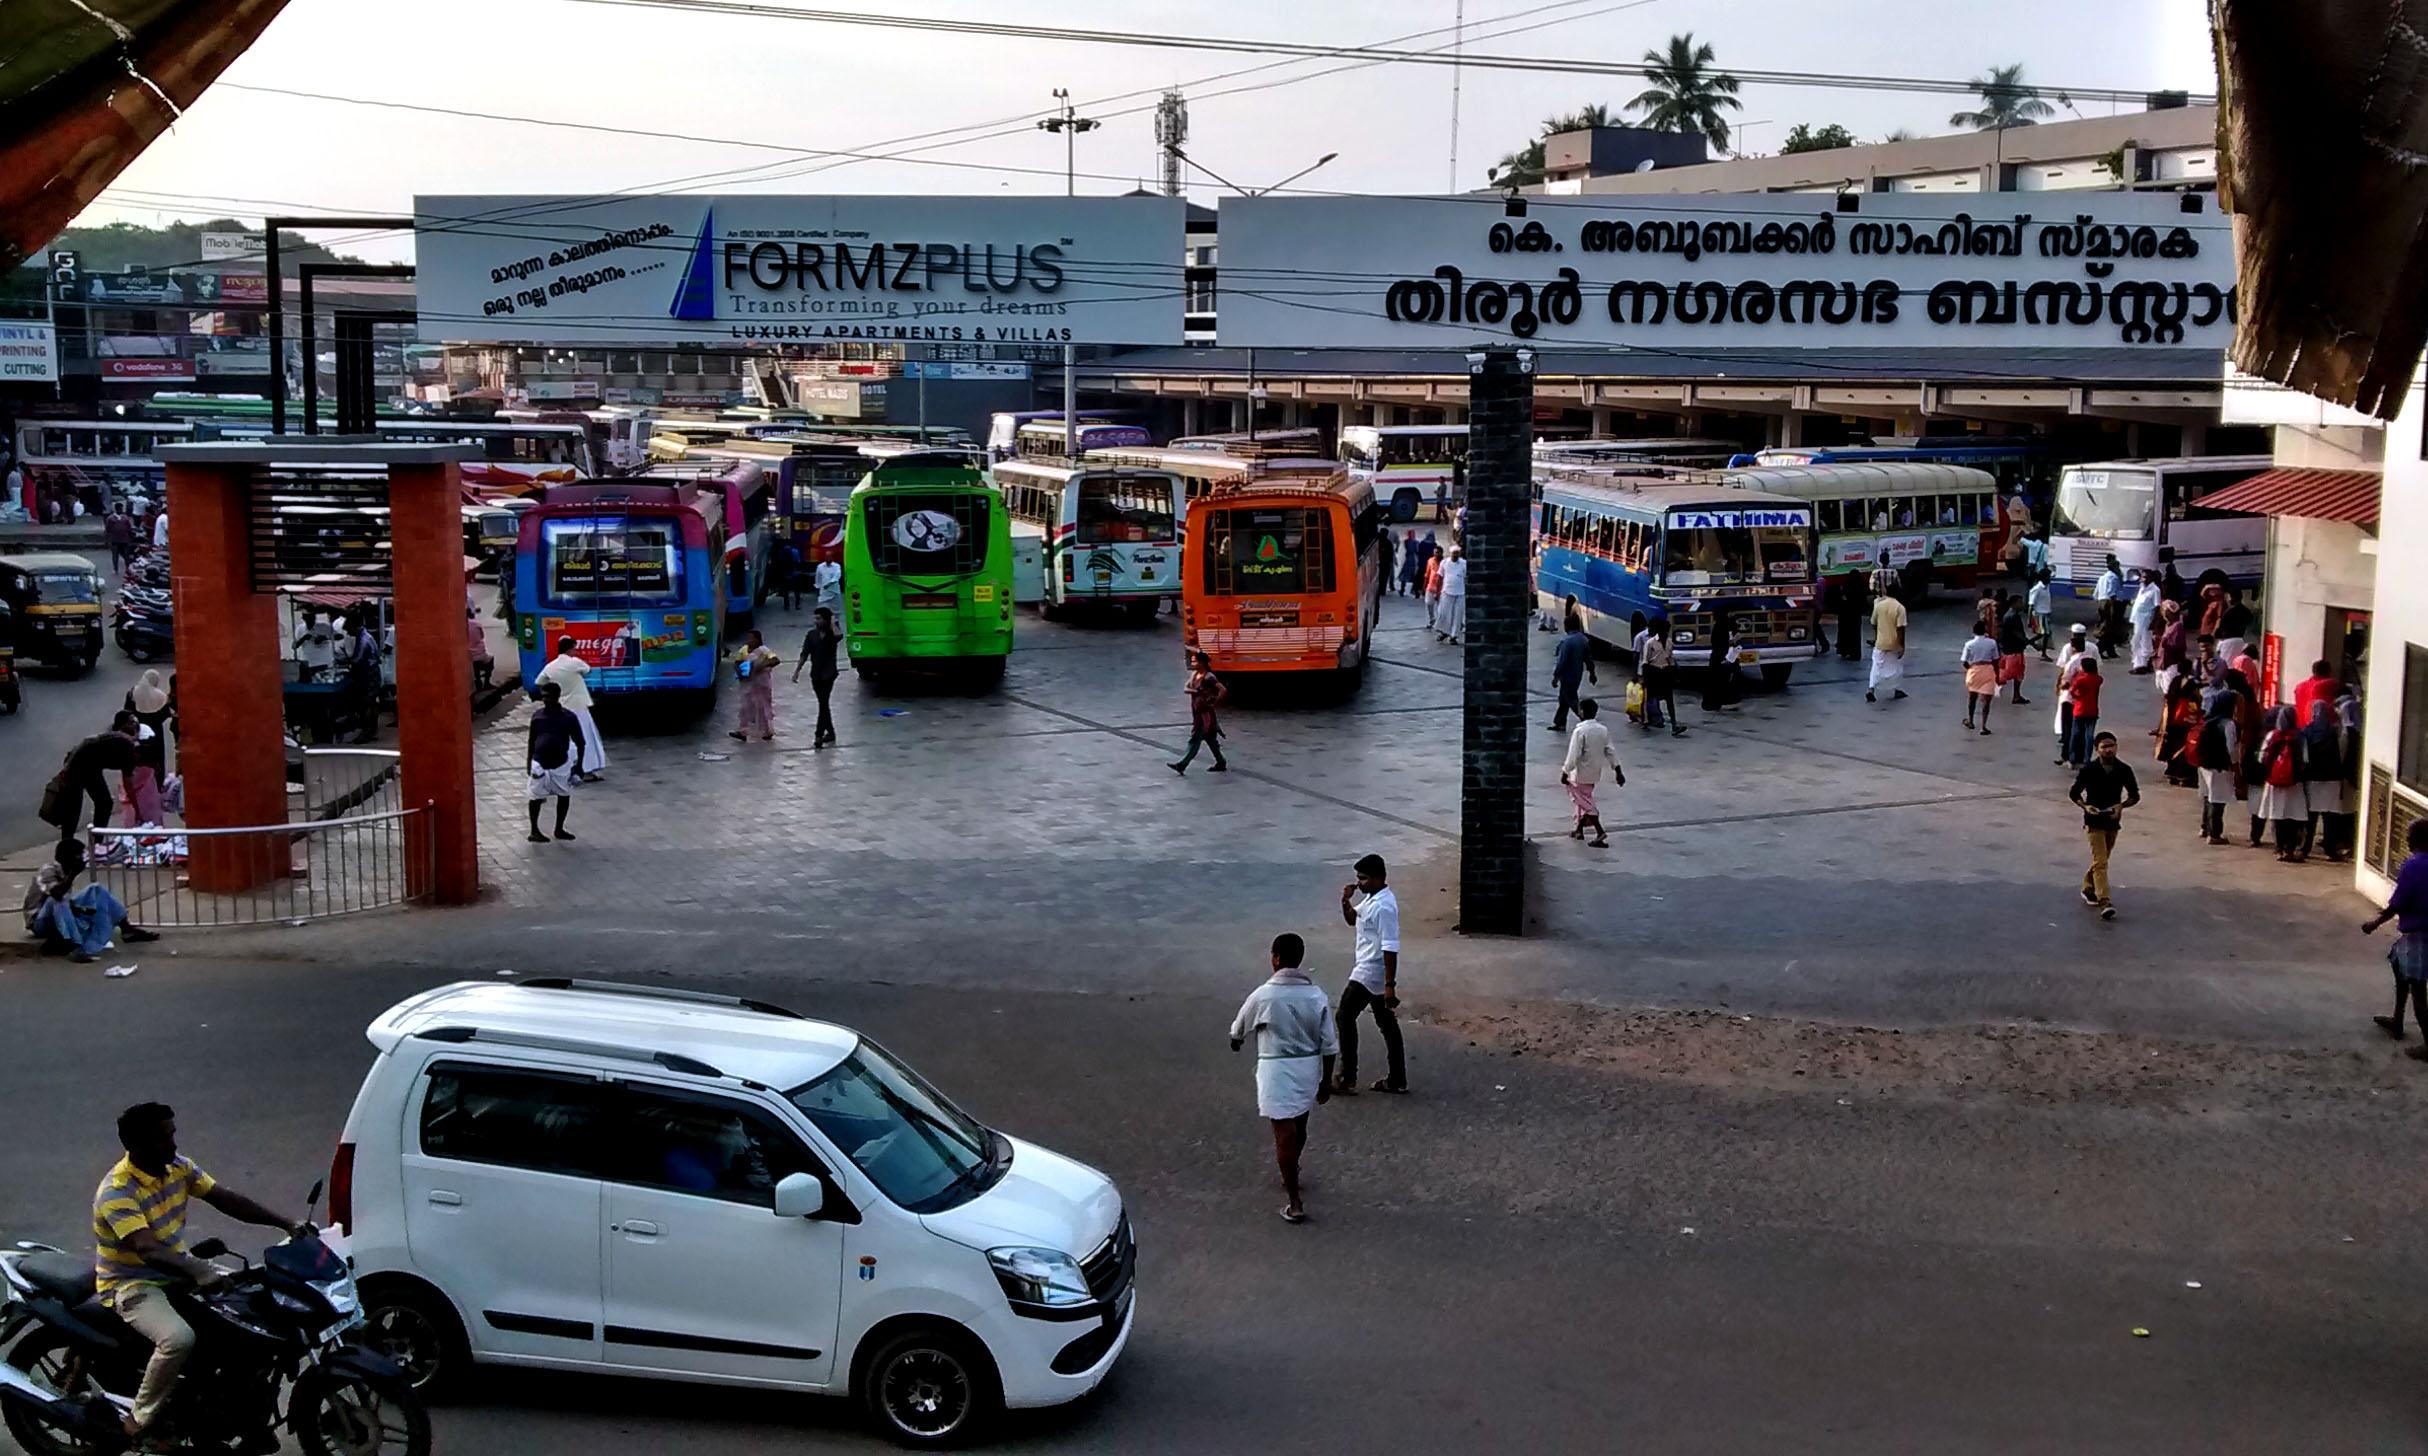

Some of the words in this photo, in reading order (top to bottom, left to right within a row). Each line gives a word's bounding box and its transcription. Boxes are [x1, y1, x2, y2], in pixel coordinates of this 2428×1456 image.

[723, 242, 1064, 294] FORMZPLUS
[731, 295, 900, 319] Transforming
[913, 299, 967, 319] your
[979, 298, 1068, 316] dreams
[1385, 265, 1583, 339] തിരൂർ
[1608, 279, 1900, 326] നഗരസഭ
[1927, 261, 2238, 344] ബസ്സ്റ്റാ
[0, 328, 34, 340] INYL
[732, 324, 812, 339] LUXURY
[823, 325, 963, 341] APARTMENTS
[973, 327, 986, 341] &
[996, 327, 1073, 342] VILLAS
[4, 363, 47, 376] CUTTING
[126, 363, 166, 372] vodafone
[1678, 512, 1805, 528] FATHIMA
